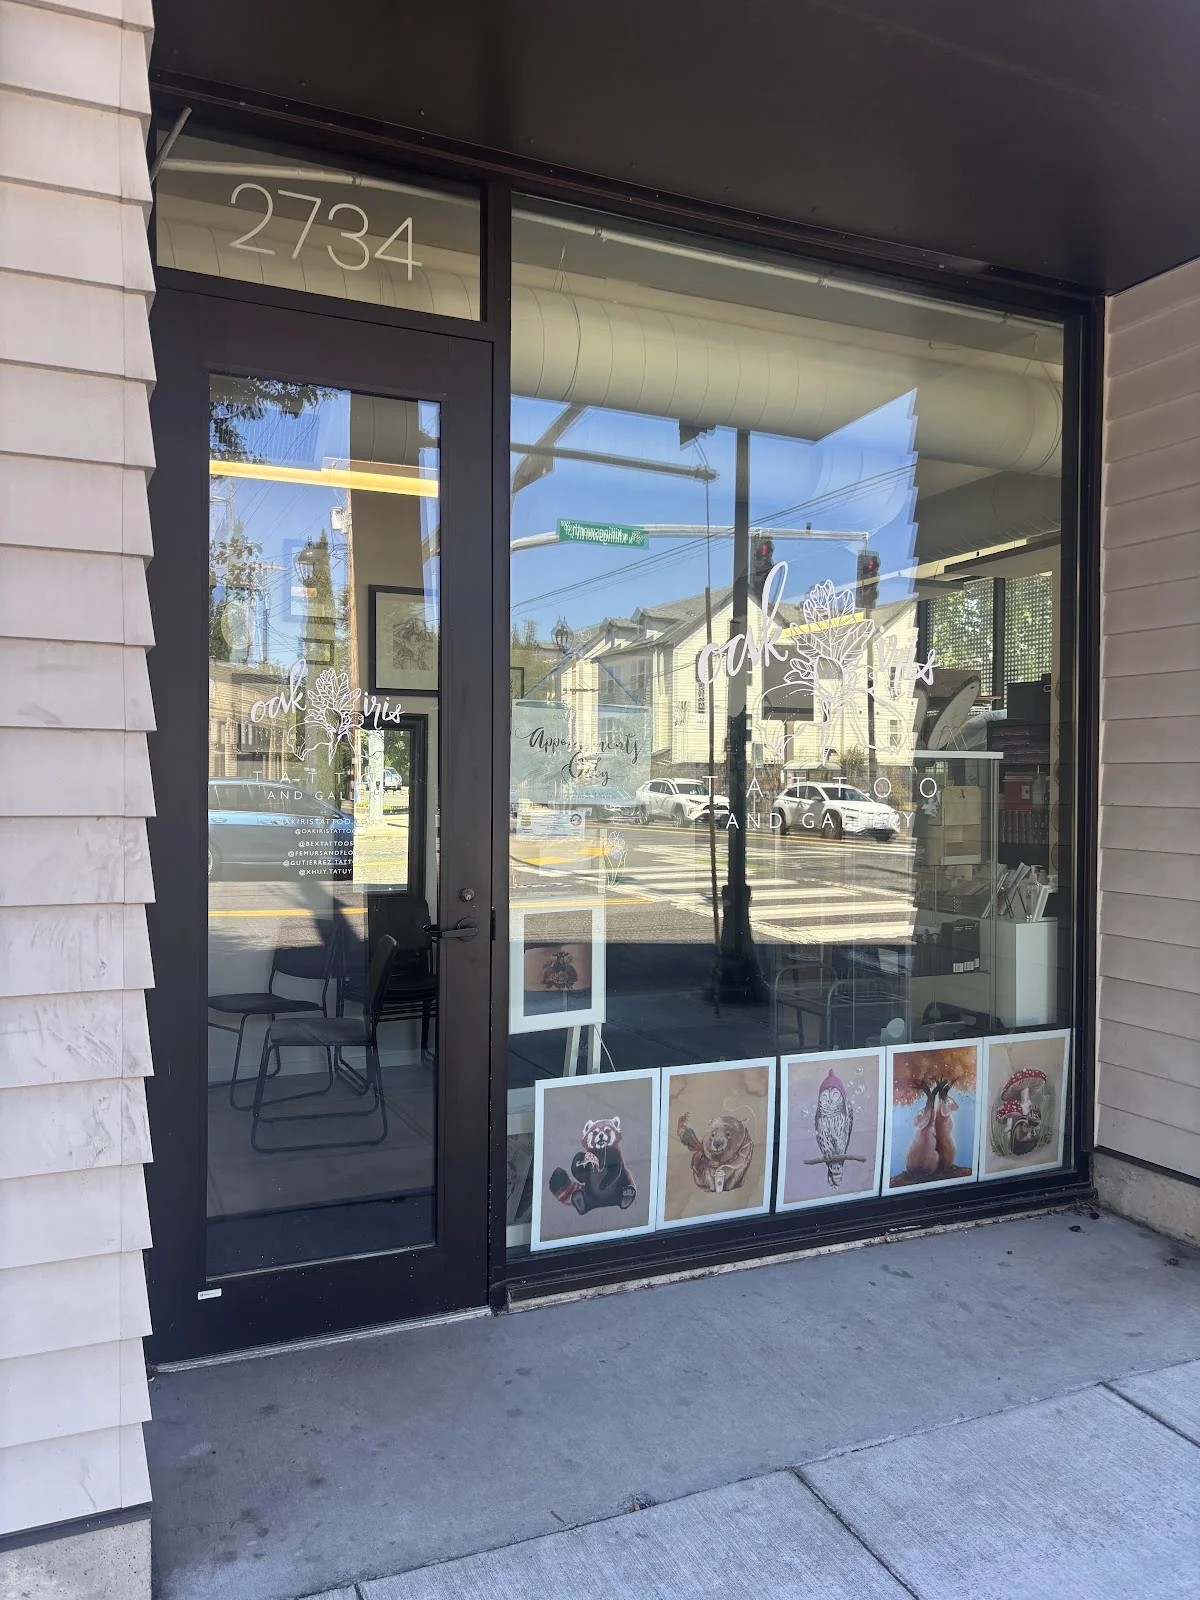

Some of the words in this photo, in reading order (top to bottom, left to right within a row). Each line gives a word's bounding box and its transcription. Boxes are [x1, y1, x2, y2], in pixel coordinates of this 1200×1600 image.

[229, 182, 423, 281] 2734
[697, 561, 788, 685] oak
[877, 625, 940, 698] iris
[250, 658, 307, 723] oak
[363, 691, 406, 731] iris
[253, 770, 362, 785] TATT
[702, 775, 938, 798] TATTOO
[267, 790, 303, 800] AND
[315, 790, 368, 801] GALL
[726, 812, 782, 829] AND
[801, 812, 915, 828] GALRY
